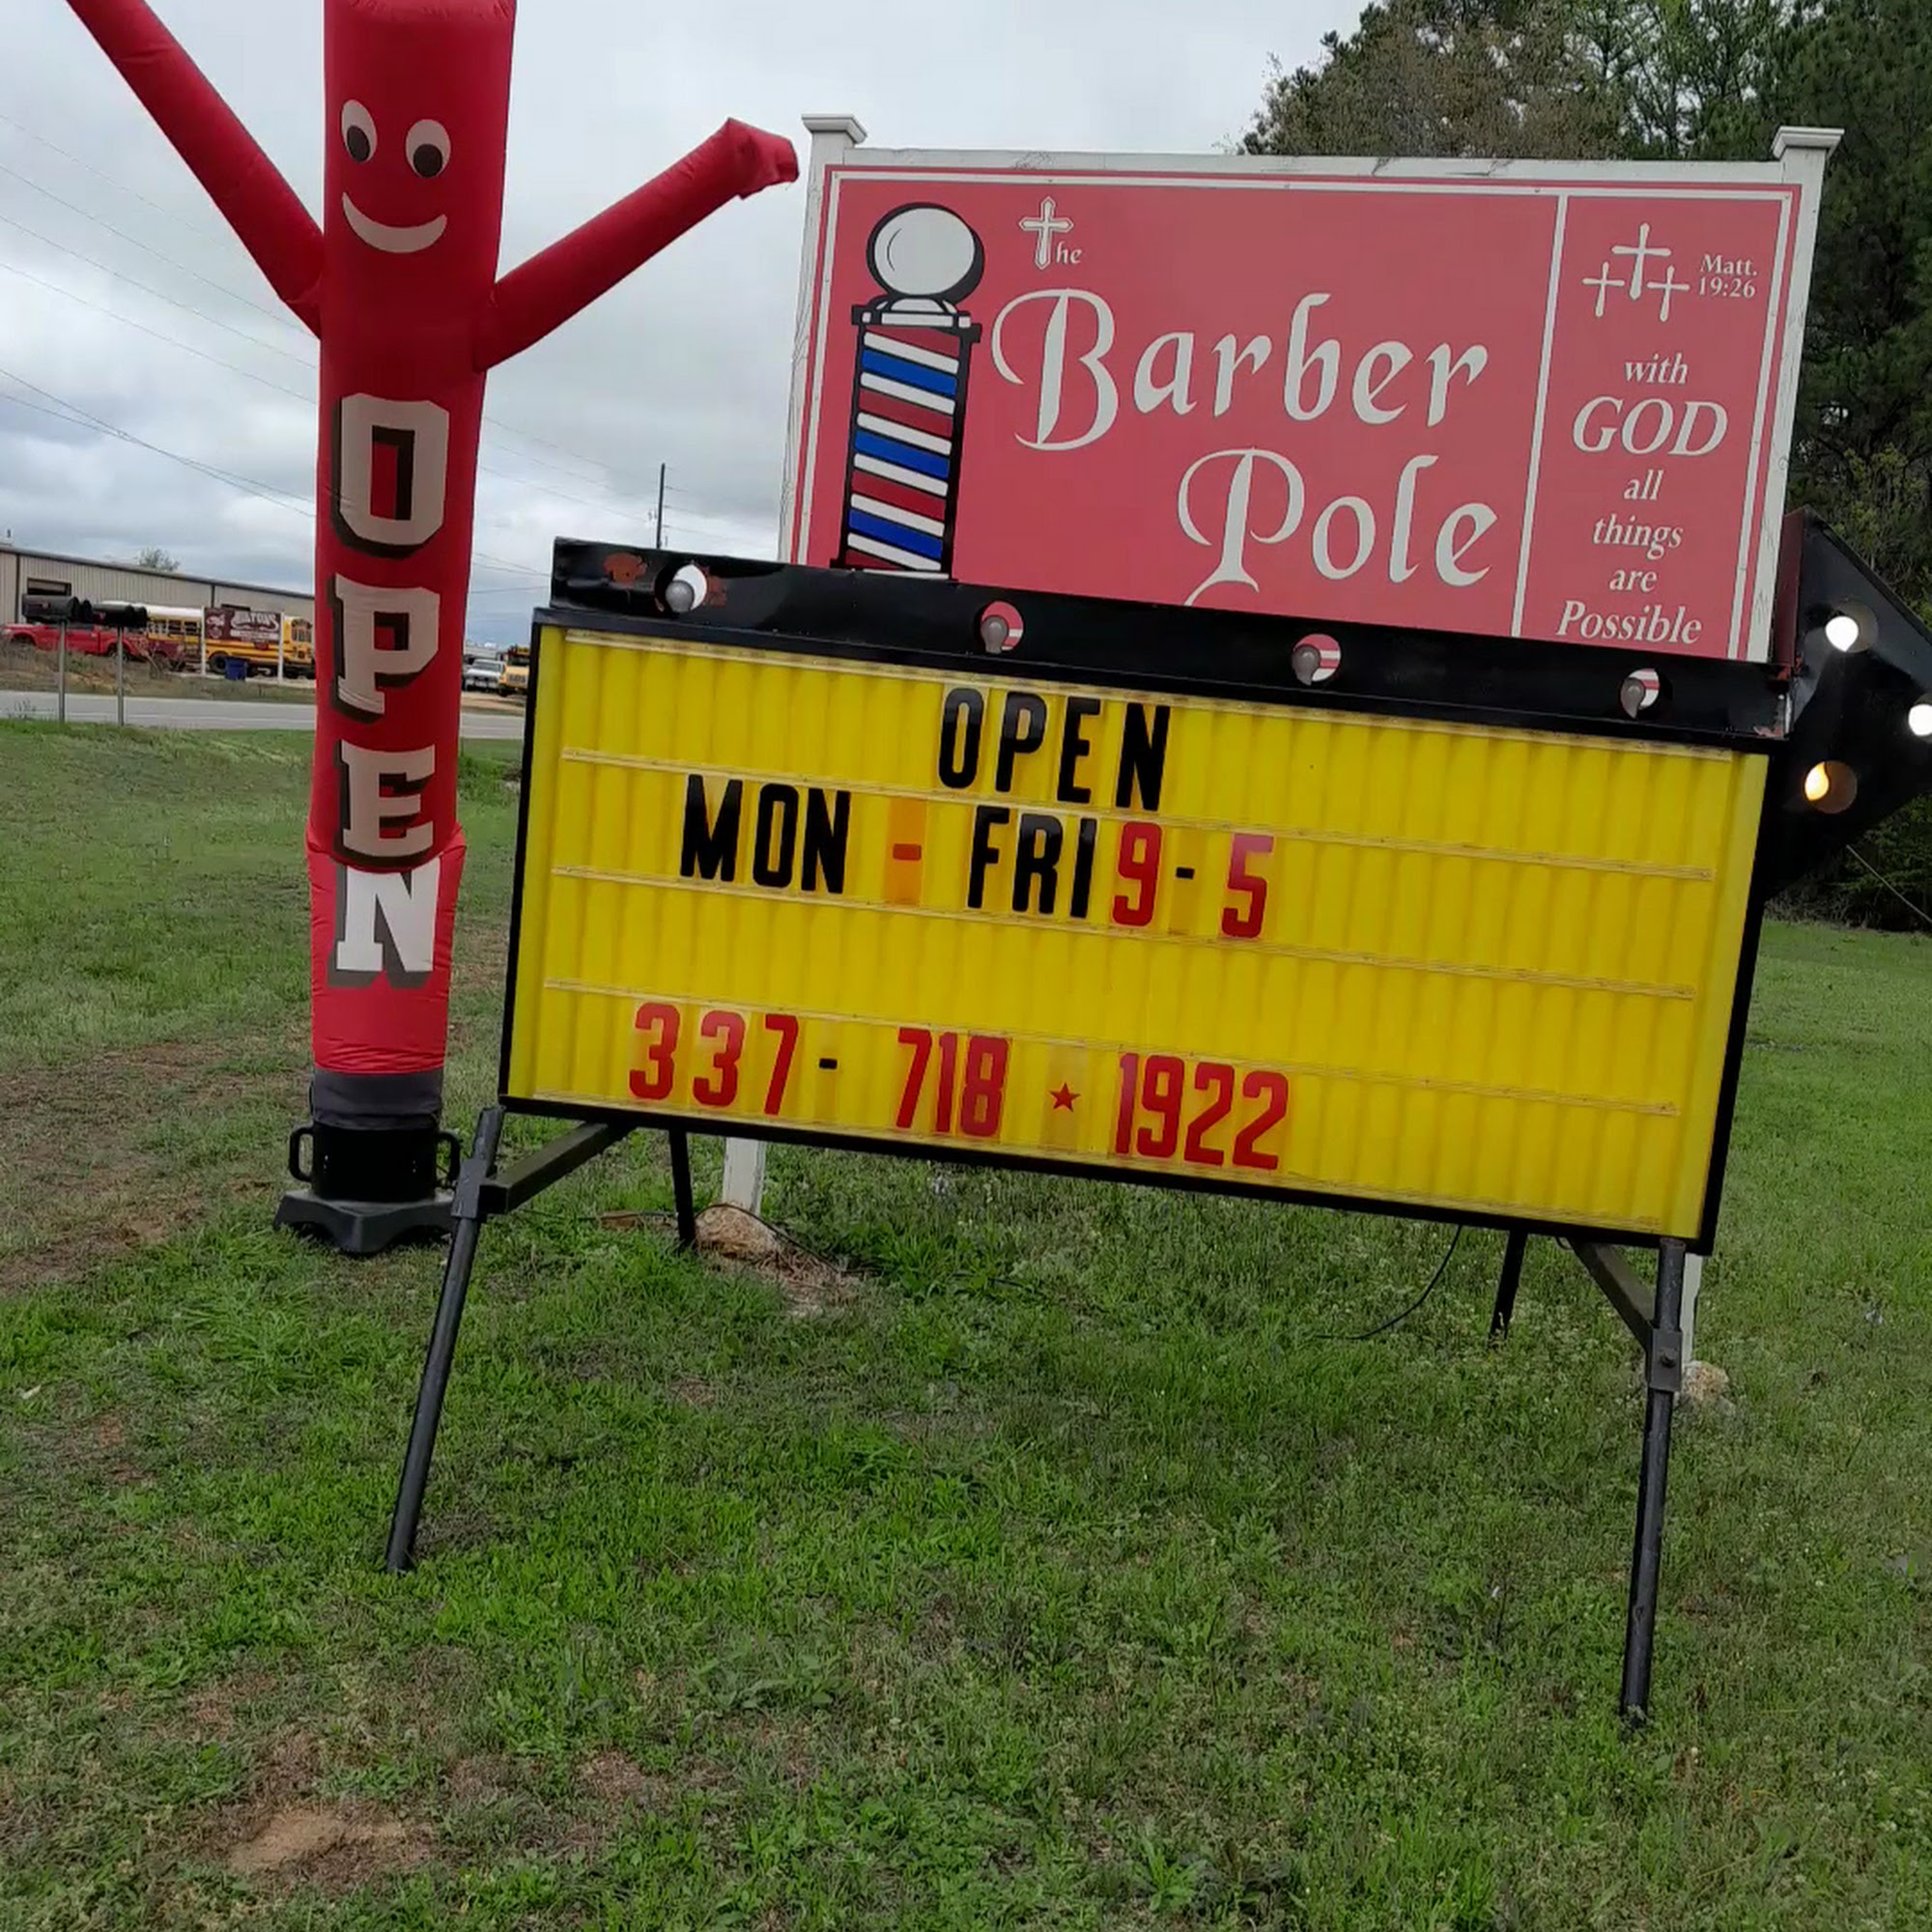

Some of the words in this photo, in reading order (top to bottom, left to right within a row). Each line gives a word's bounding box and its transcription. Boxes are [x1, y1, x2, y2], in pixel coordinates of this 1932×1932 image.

[1698, 276, 1756, 298] 19:26
[1699, 254, 1758, 276] Matt.
[991, 288, 1489, 451] Barber
[1624, 353, 1689, 384] with
[1572, 395, 1729, 457] GOD
[1624, 469, 1664, 500] all
[1177, 447, 1497, 606] Pole
[1592, 514, 1683, 560] things
[1608, 564, 1658, 593] are
[1555, 600, 1702, 644] Possible
[937, 687, 1171, 811] OPEN
[679, 774, 851, 894] MON
